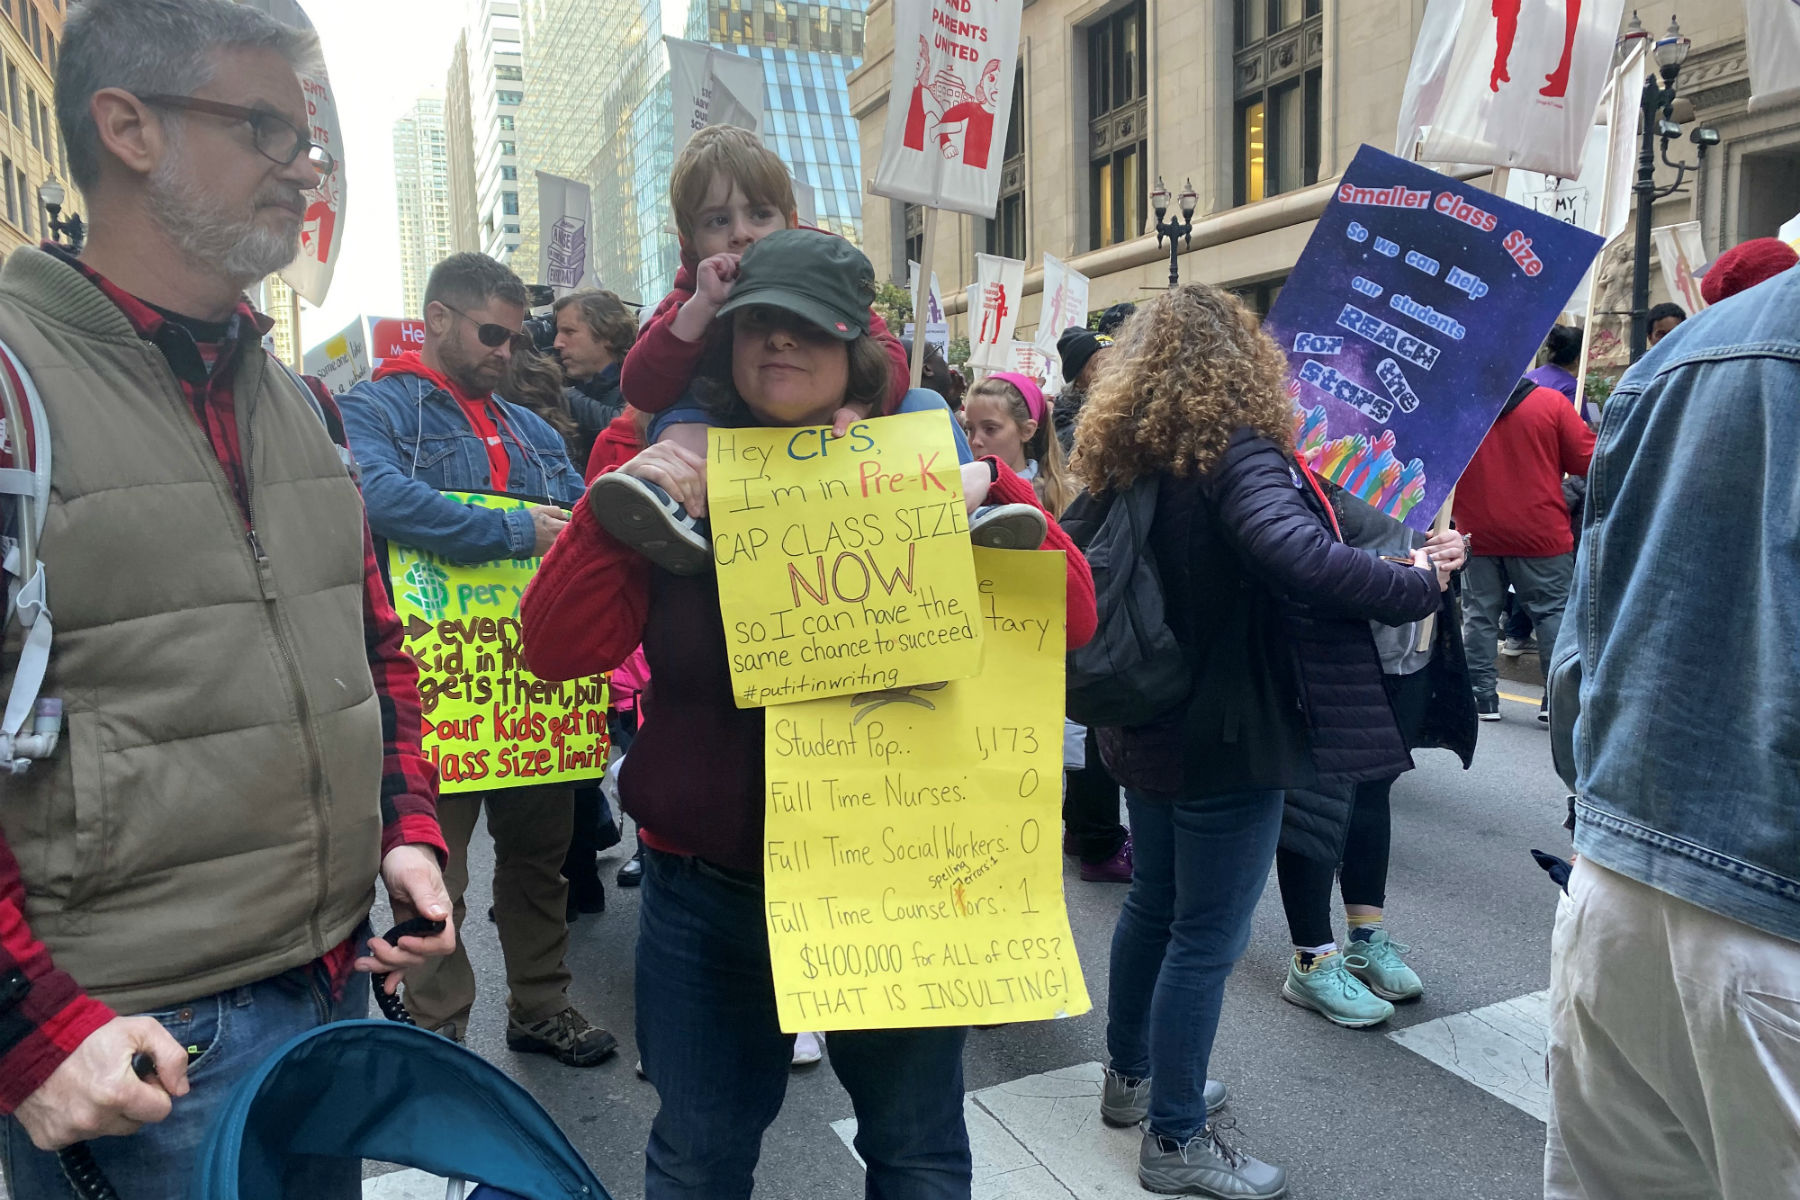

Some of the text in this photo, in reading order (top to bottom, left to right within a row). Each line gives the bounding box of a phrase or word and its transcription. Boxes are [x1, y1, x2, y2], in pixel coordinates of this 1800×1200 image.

[932, 8, 988, 42] PARENTS
[934, 32, 979, 63] UNITED
[1555, 196, 1577, 212] MY
[1339, 183, 1543, 276] Smaller Class Size
[1374, 236, 1400, 257] we
[1405, 250, 1440, 276] can
[1446, 266, 1489, 300] help
[1352, 276, 1466, 339] our students
[1338, 305, 1439, 369] REACH
[717, 434, 774, 479] Hey
[820, 478, 850, 500] in
[859, 451, 959, 499] Pre-K,
[713, 499, 970, 566] CAP CLASS SIZE
[456, 583, 506, 616] per
[770, 607, 796, 641] I
[802, 610, 856, 636] can
[860, 600, 912, 626] have
[916, 585, 964, 620] the
[475, 645, 496, 674] in
[733, 650, 794, 674] same
[800, 636, 872, 664] chance
[875, 628, 895, 656] to
[418, 667, 493, 715] gets
[743, 663, 900, 701] #putitinwriting
[435, 701, 608, 748] our kids get no
[775, 718, 857, 759] Student
[975, 725, 1040, 760] 1,173
[421, 744, 490, 784] lass
[495, 743, 554, 778] size
[771, 780, 813, 814] Full
[821, 778, 876, 812] Time
[1018, 767, 1040, 798] 0
[767, 839, 811, 874] Full
[821, 835, 871, 867] Time
[881, 825, 939, 864] Social
[1020, 818, 1040, 854] 0
[768, 901, 809, 934] Full
[817, 896, 873, 930] Time
[800, 937, 1062, 980] $400,000 for ALL of CPS?
[786, 965, 1070, 1020] THAT IS INSULTING!
